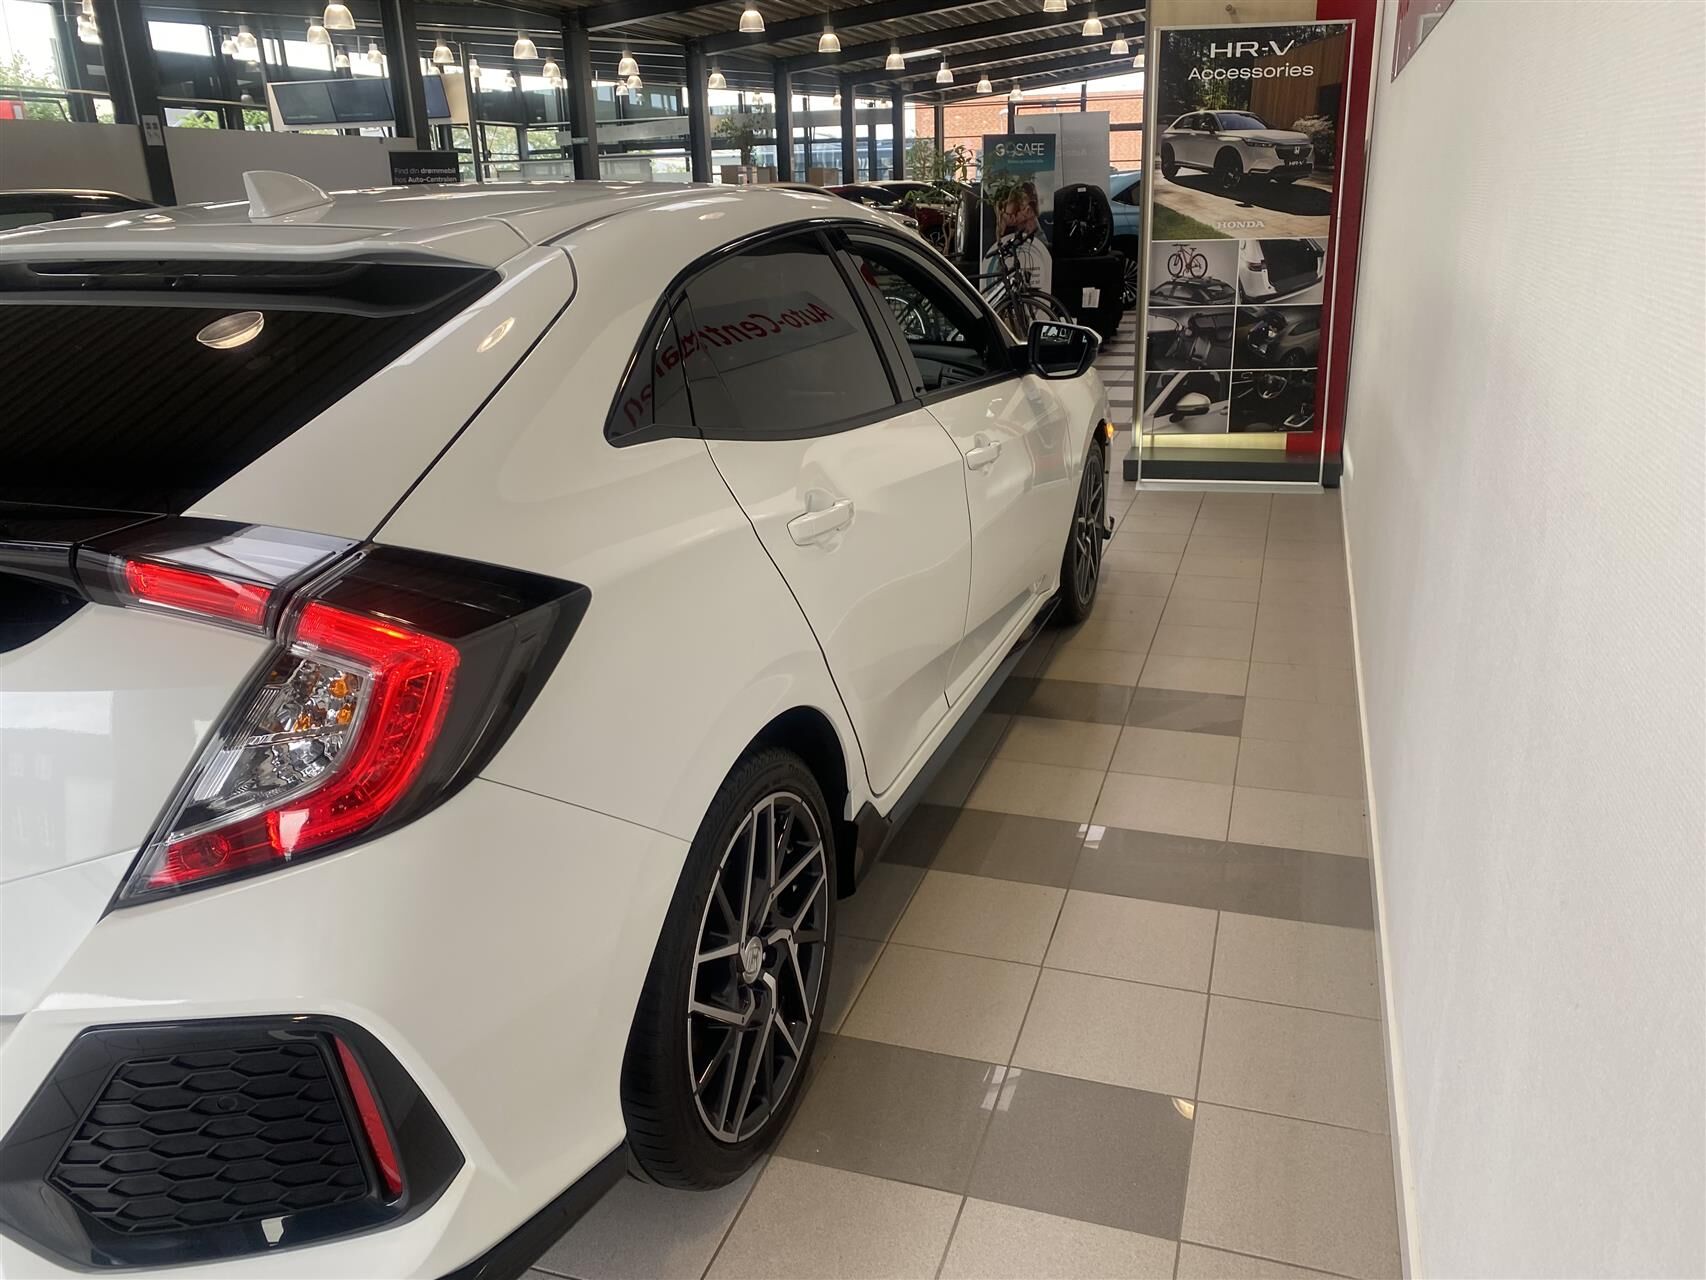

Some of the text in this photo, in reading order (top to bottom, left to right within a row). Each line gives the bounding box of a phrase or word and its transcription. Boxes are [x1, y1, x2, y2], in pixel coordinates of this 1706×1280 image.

[1210, 40, 1295, 58] HR-V
[1188, 63, 1314, 80] Accessories
[1216, 221, 1265, 229] HONDA
